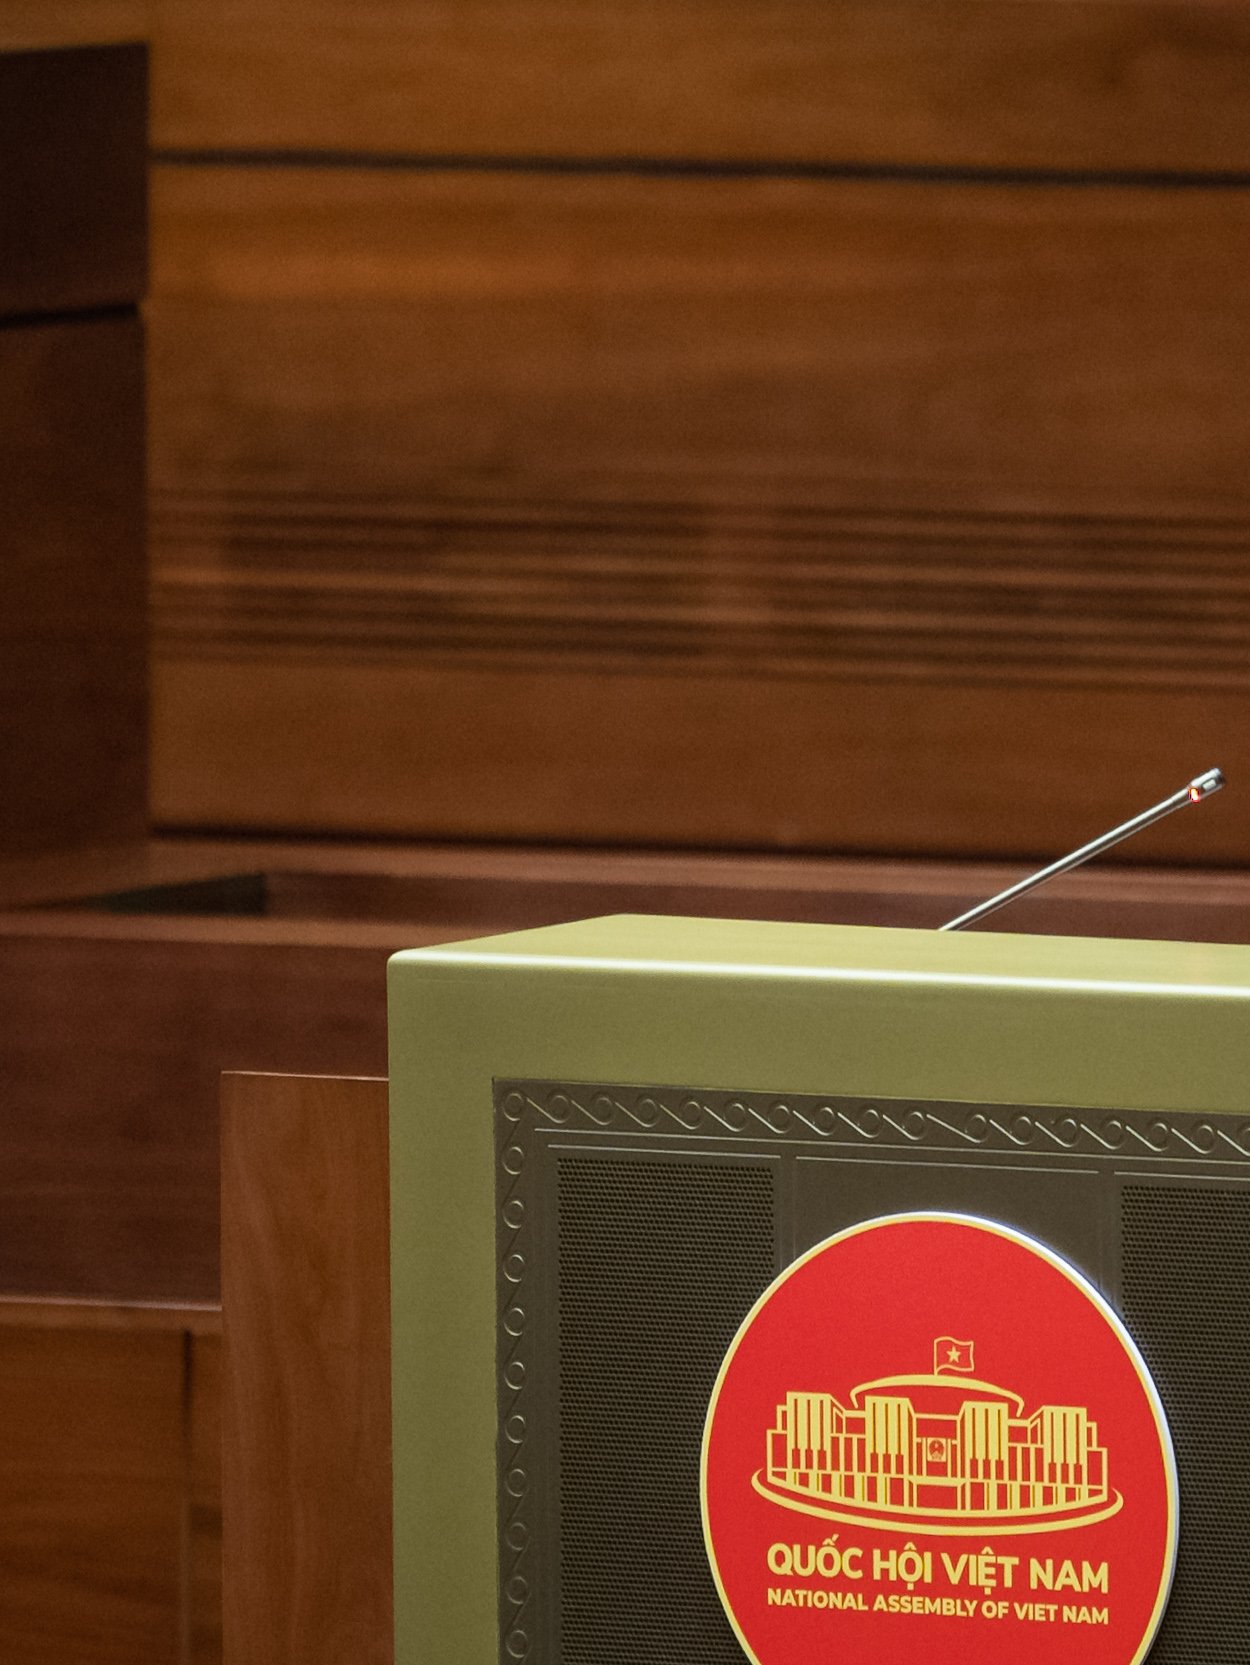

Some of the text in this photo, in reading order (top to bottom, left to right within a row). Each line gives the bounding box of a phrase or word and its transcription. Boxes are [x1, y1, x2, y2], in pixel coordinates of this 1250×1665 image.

[767, 1534, 1109, 1595] QUỐC HỘI VIỆT NAM
[767, 1588, 1109, 1624] NATIONAL ASSEMBLY OF VIET NAM
